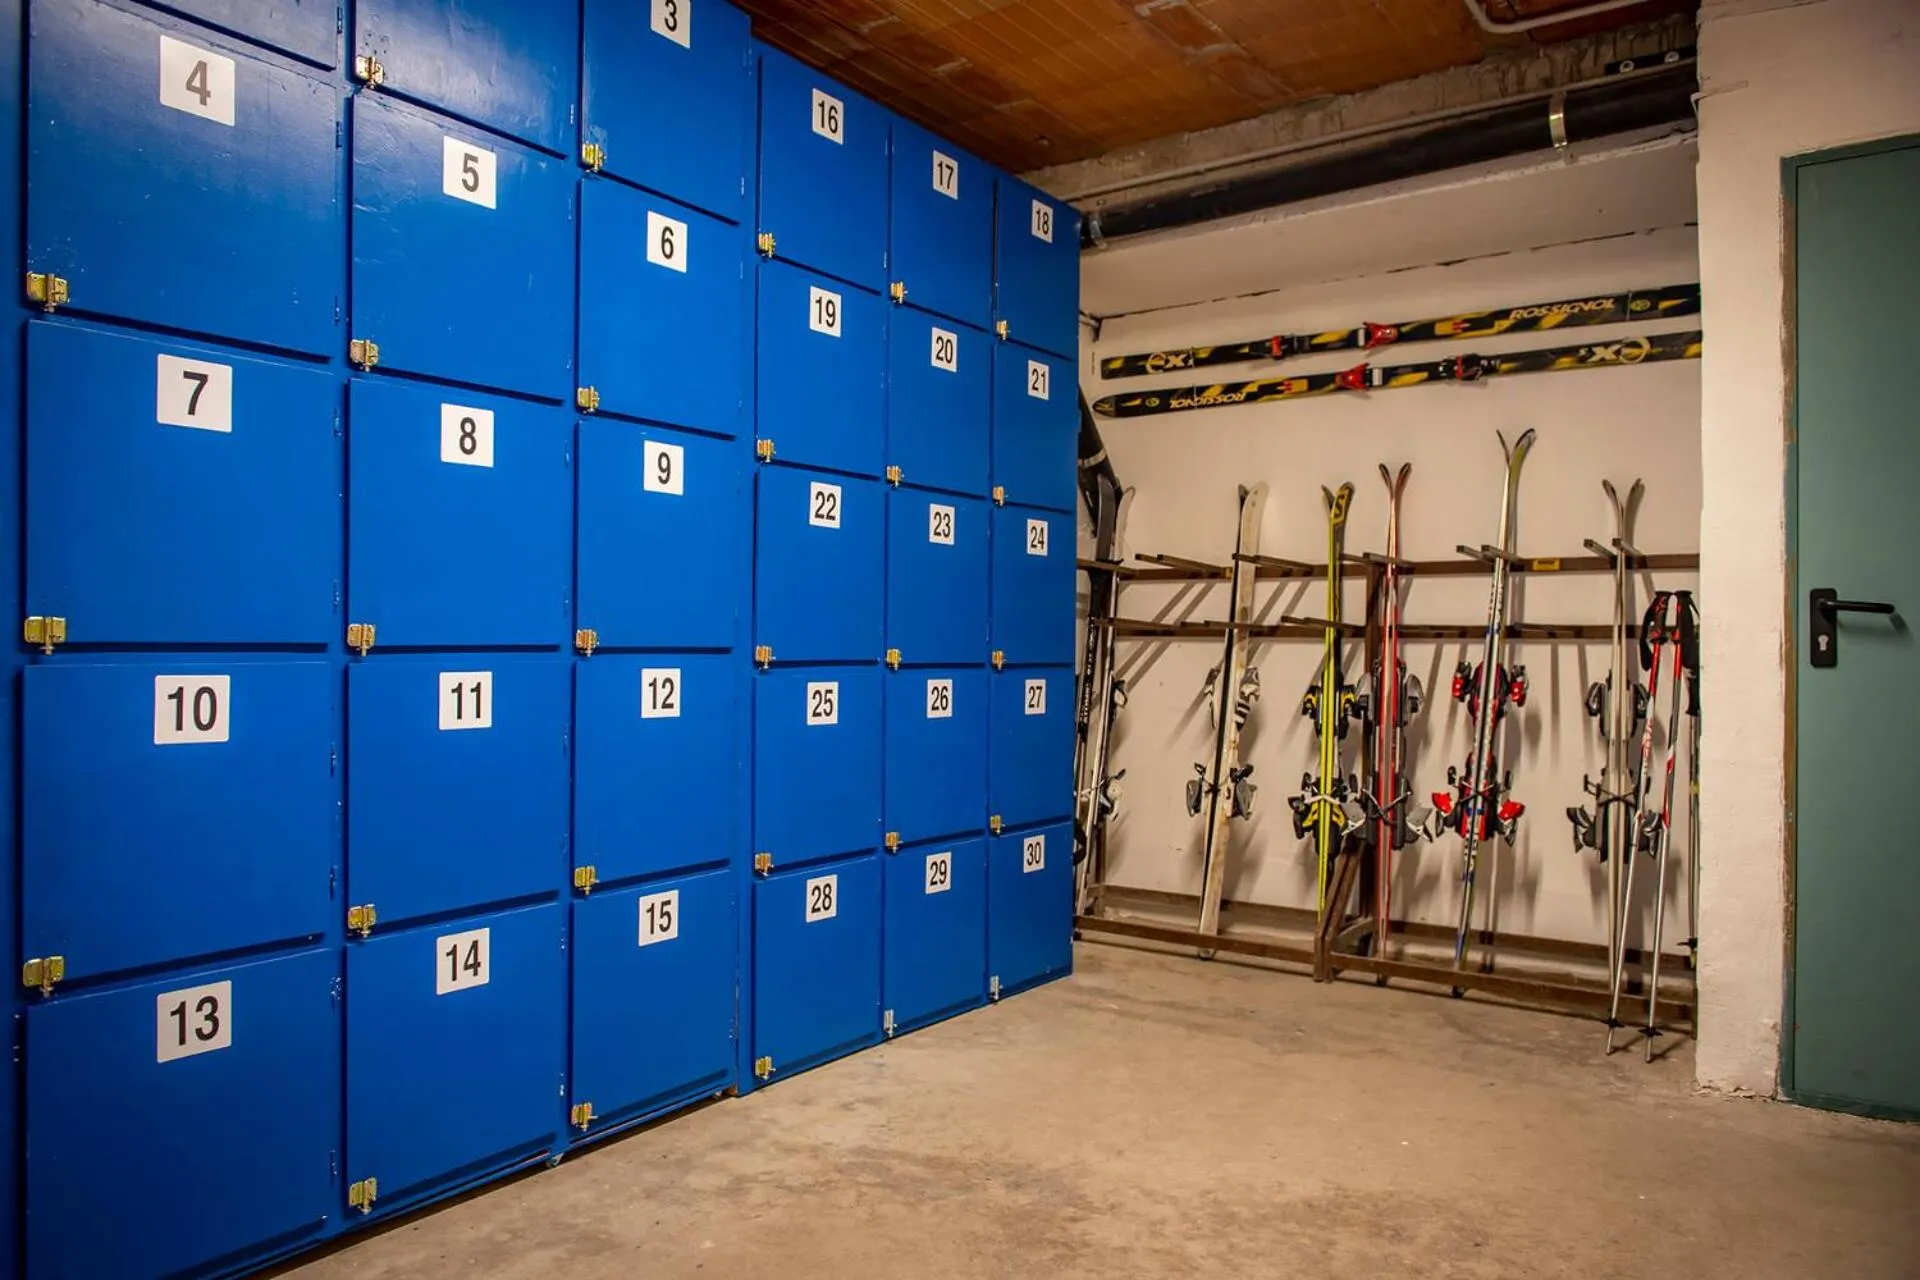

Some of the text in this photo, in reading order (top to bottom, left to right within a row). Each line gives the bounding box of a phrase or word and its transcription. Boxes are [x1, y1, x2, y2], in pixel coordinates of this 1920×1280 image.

[664, 0, 677, 32] 3
[186, 60, 211, 106] 4
[818, 100, 838, 134] 16
[462, 153, 479, 193] 5
[937, 160, 954, 189] 17
[1036, 209, 1049, 235] 18
[661, 226, 674, 259] 6
[815, 297, 836, 328] 19
[1509, 298, 1616, 321] ROSSIGNOL
[936, 336, 953, 364] 20
[183, 371, 208, 416] 7
[1032, 368, 1047, 393] 21
[459, 417, 476, 455] 8
[658, 452, 671, 484] 9
[815, 491, 836, 521] 22
[933, 512, 951, 538] 23
[1031, 526, 1044, 550] 24
[168, 686, 217, 731] 10
[451, 682, 481, 720] 11
[649, 677, 674, 710] 12
[812, 689, 833, 717] 25
[931, 686, 948, 711] 26
[1028, 686, 1043, 708] 27
[1027, 842, 1041, 866] 30
[930, 860, 947, 886] 29
[811, 883, 832, 913] 28
[646, 900, 672, 935] 15
[446, 940, 481, 981] 14
[170, 996, 219, 1046] 13
